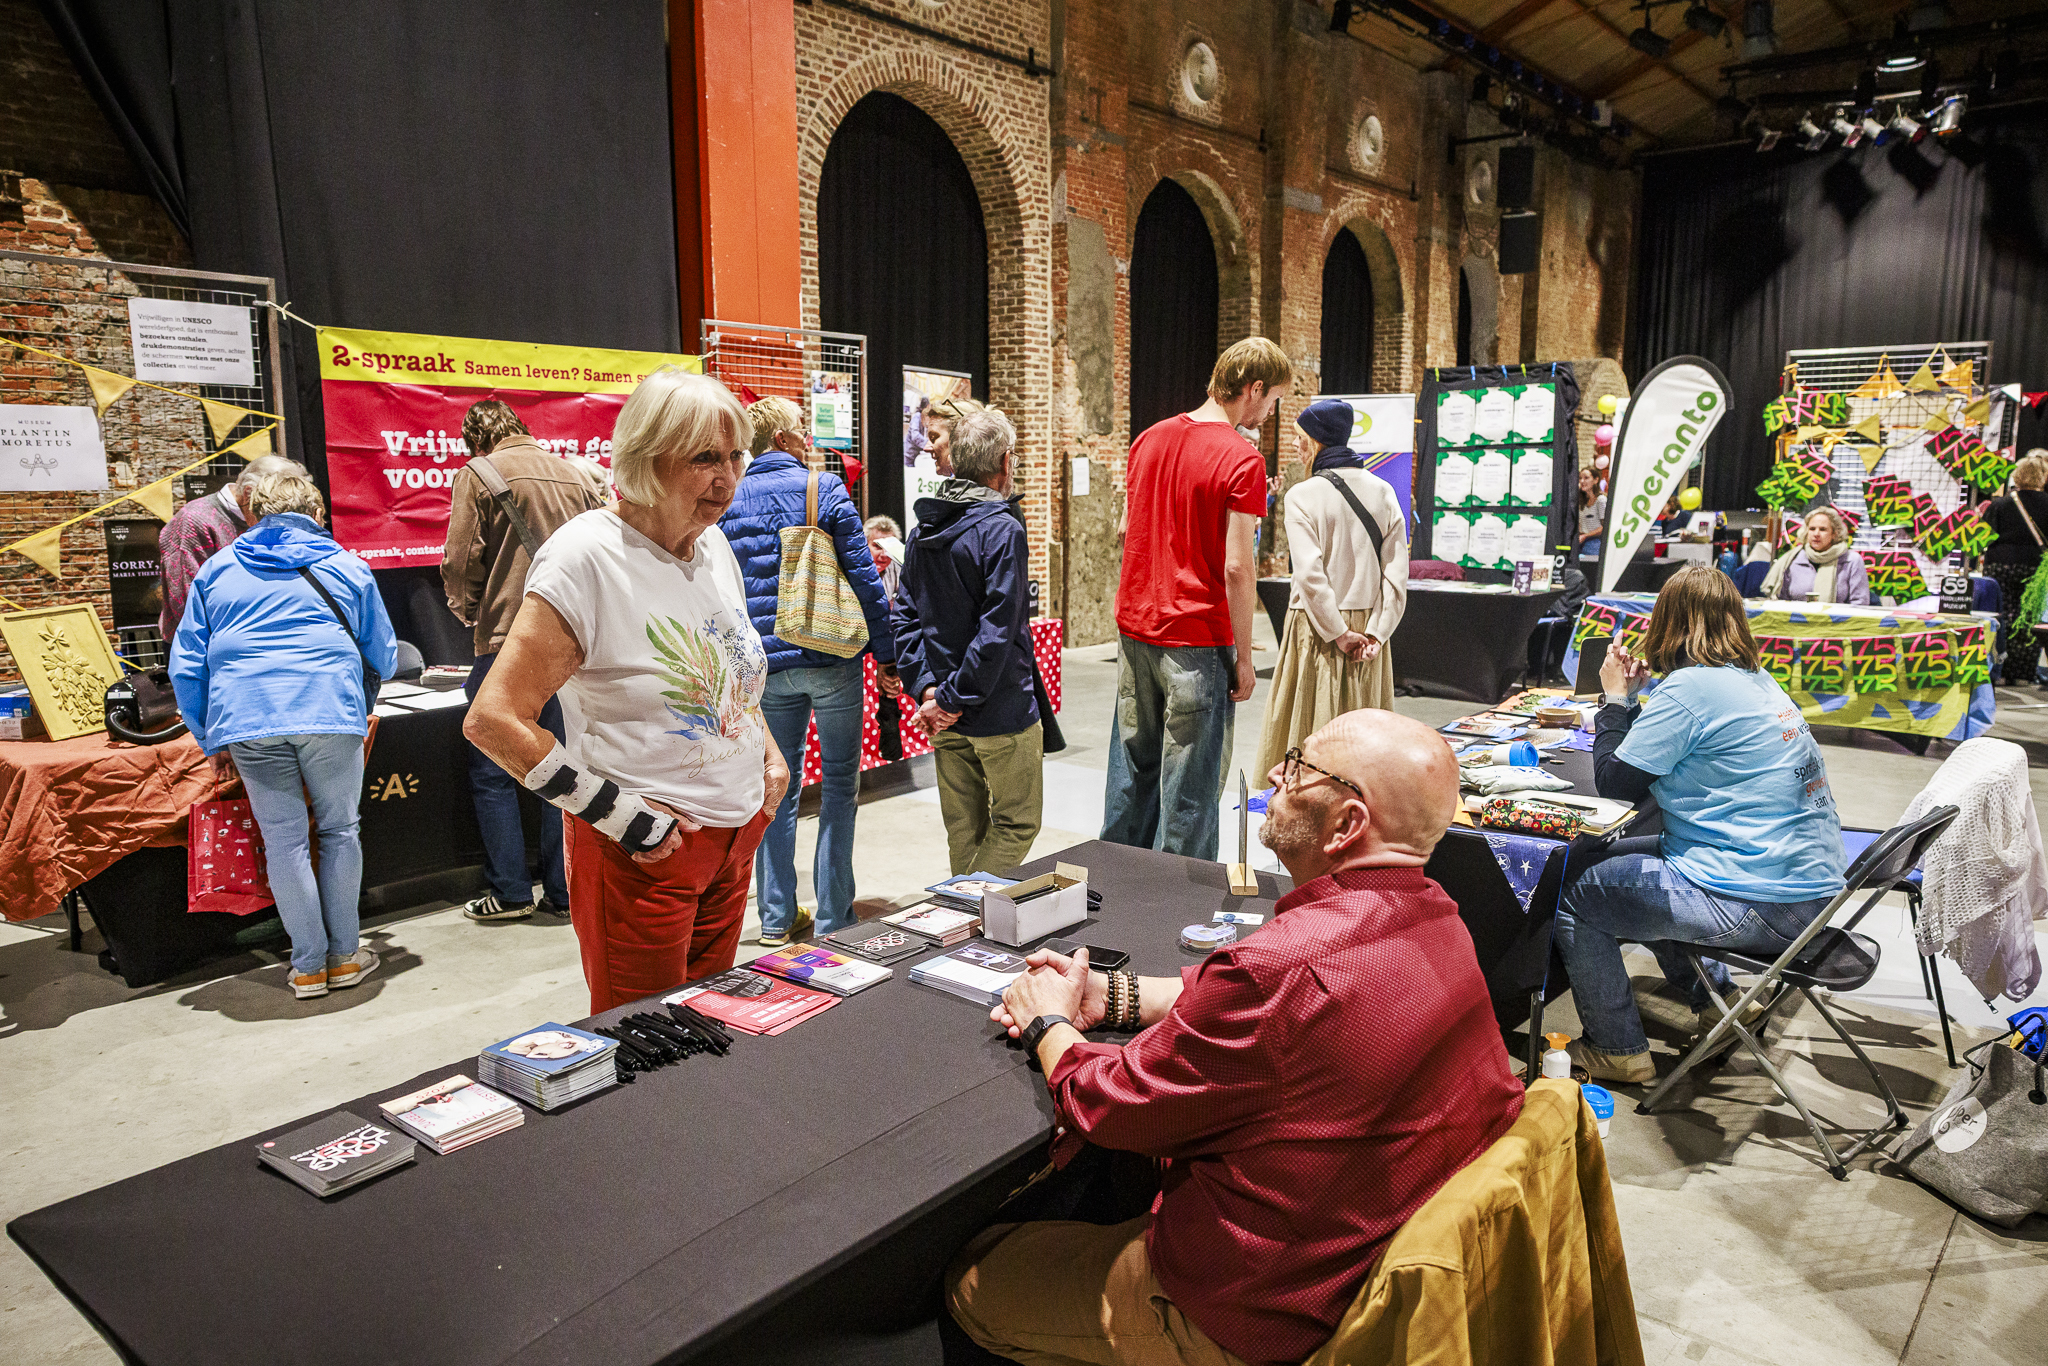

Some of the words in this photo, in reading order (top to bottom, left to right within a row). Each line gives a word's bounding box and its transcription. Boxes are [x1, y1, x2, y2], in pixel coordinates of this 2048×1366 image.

[182, 316, 212, 325] UNESCO
[140, 332, 176, 341] bezoekers
[140, 342, 206, 352] drukdemonstraties
[142, 361, 177, 369] collecties
[184, 354, 208, 362] werken
[332, 344, 456, 374] 2-spraak
[464, 360, 522, 378] Samen
[526, 364, 580, 380] leven?
[583, 368, 632, 384] Samen
[0, 428, 71, 436] PLANTIN
[2, 439, 72, 447] MORETUS
[1613, 391, 1718, 549] esperanto
[348, 546, 405, 560] 2-spraak,
[112, 560, 160, 570] SORRY,
[1942, 577, 1968, 596] 59
[1782, 727, 1800, 742] een
[380, 773, 408, 802] A
[1814, 795, 1829, 809] aan
[296, 1126, 386, 1170] DOEK
[315, 1131, 391, 1172] JONG
